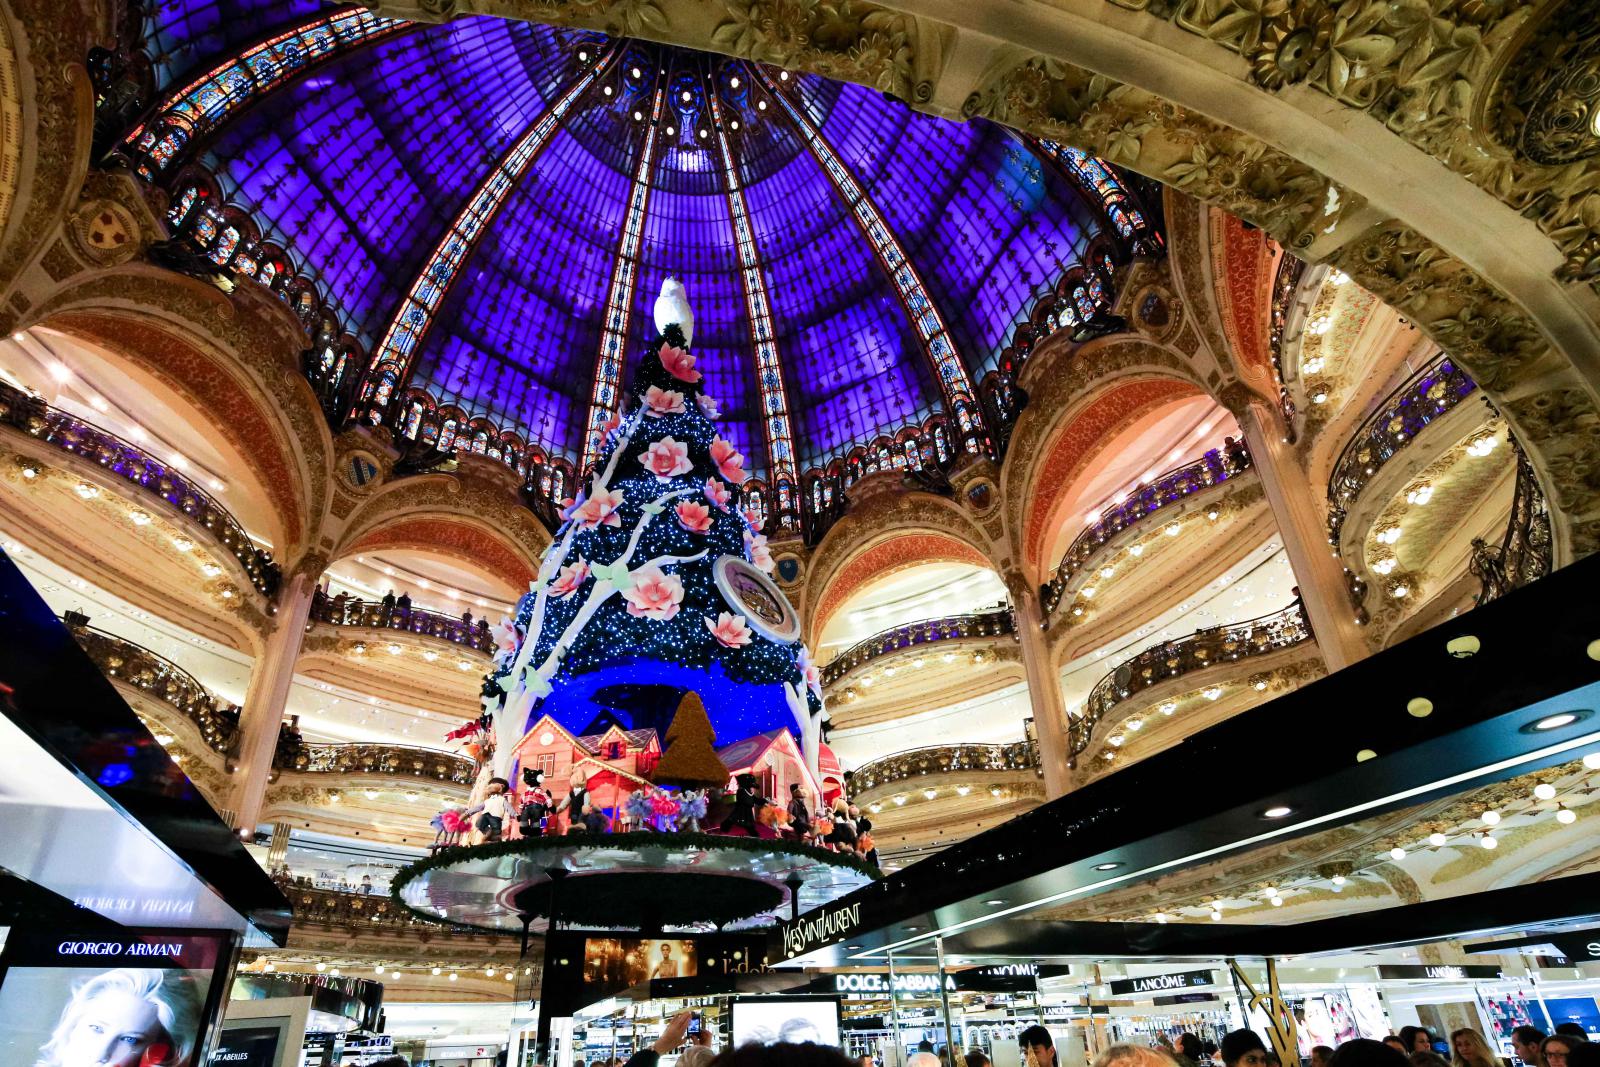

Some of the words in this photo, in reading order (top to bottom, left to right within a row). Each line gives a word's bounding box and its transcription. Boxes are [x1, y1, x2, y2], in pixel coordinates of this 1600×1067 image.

[58, 941, 123, 955] GIORGIO
[125, 943, 183, 956] ARMANI
[836, 974, 882, 991] DOLCE
[1133, 974, 1187, 992] LANCÔME
